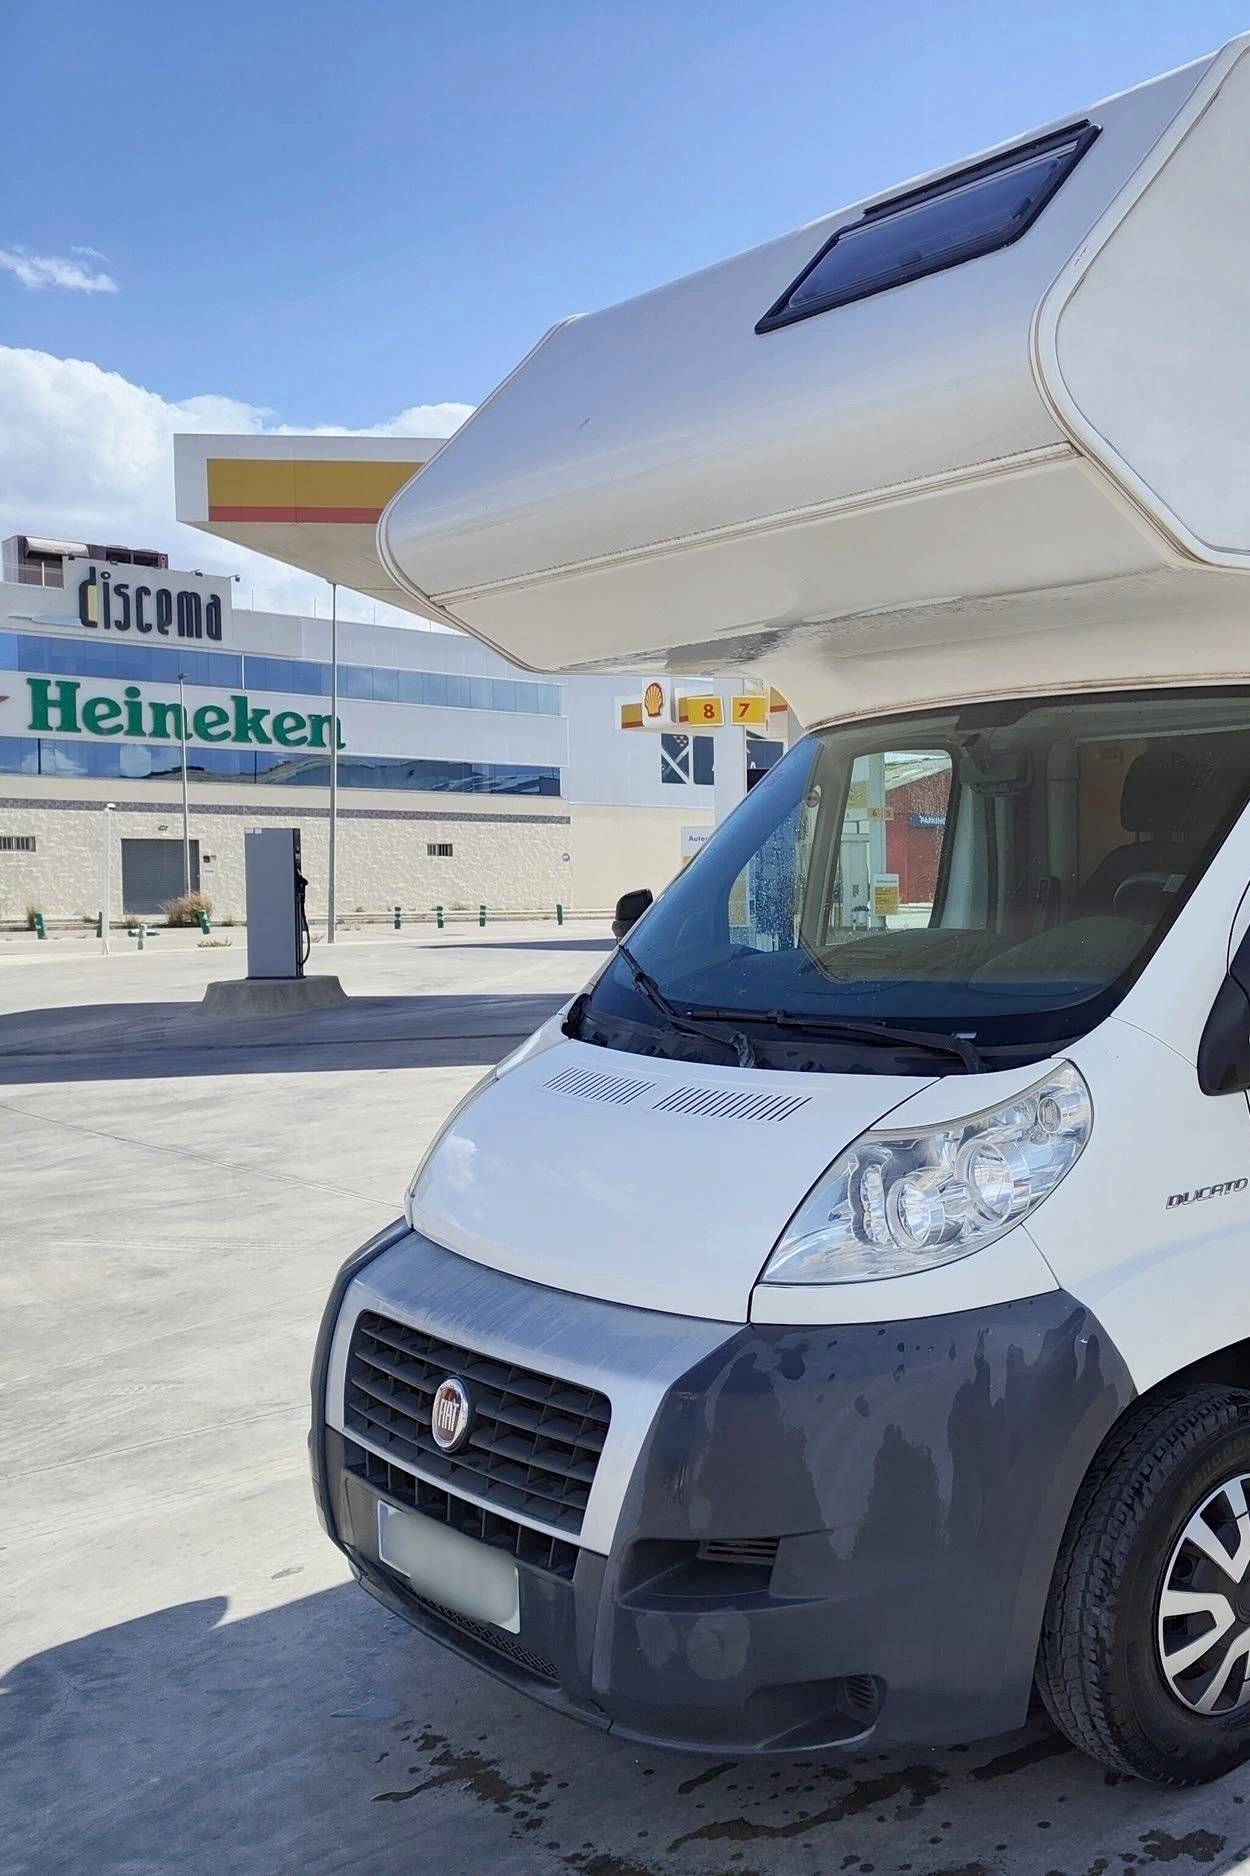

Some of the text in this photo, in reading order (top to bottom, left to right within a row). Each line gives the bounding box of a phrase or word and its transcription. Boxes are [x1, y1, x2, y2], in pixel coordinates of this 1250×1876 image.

[78, 566, 222, 641] discema
[26, 677, 346, 750] Heineken
[703, 703, 715, 719] 8
[738, 702, 751, 718] 7
[1166, 1177, 1248, 1210] DUCATO
[438, 1398, 460, 1432] FIAT
